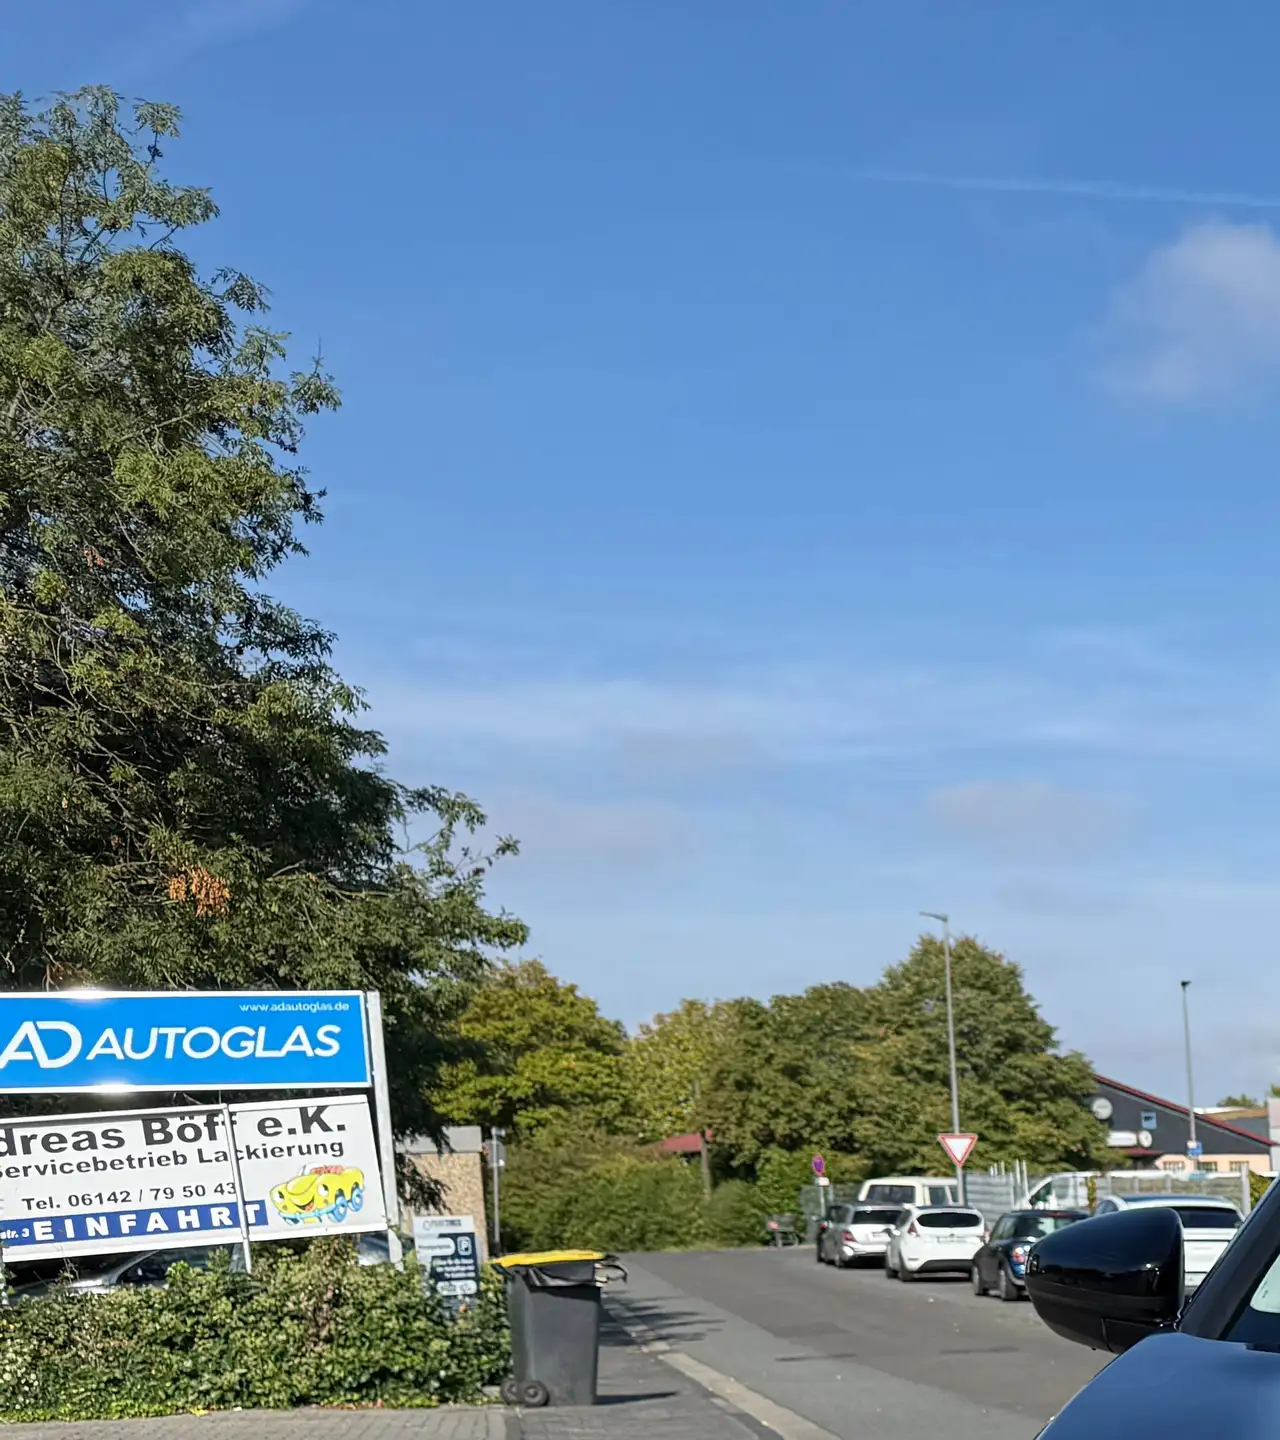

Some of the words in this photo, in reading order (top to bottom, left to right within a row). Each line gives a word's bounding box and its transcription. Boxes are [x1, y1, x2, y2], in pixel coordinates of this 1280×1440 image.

[239, 1001, 349, 1013] www.adautoglas.de
[0, 1021, 82, 1069] AD
[86, 1024, 342, 1060] AUTOGLAS
[257, 1105, 346, 1137] e.K.
[0, 1150, 187, 1178] ervicebetrieb
[22, 1197, 61, 1211] Tel.
[68, 1190, 131, 1207] 06142
[150, 1186, 174, 1201] 79
[183, 1184, 206, 1198] 50
[214, 1182, 236, 1196] 43
[33, 1203, 260, 1241] EINFAHRT
